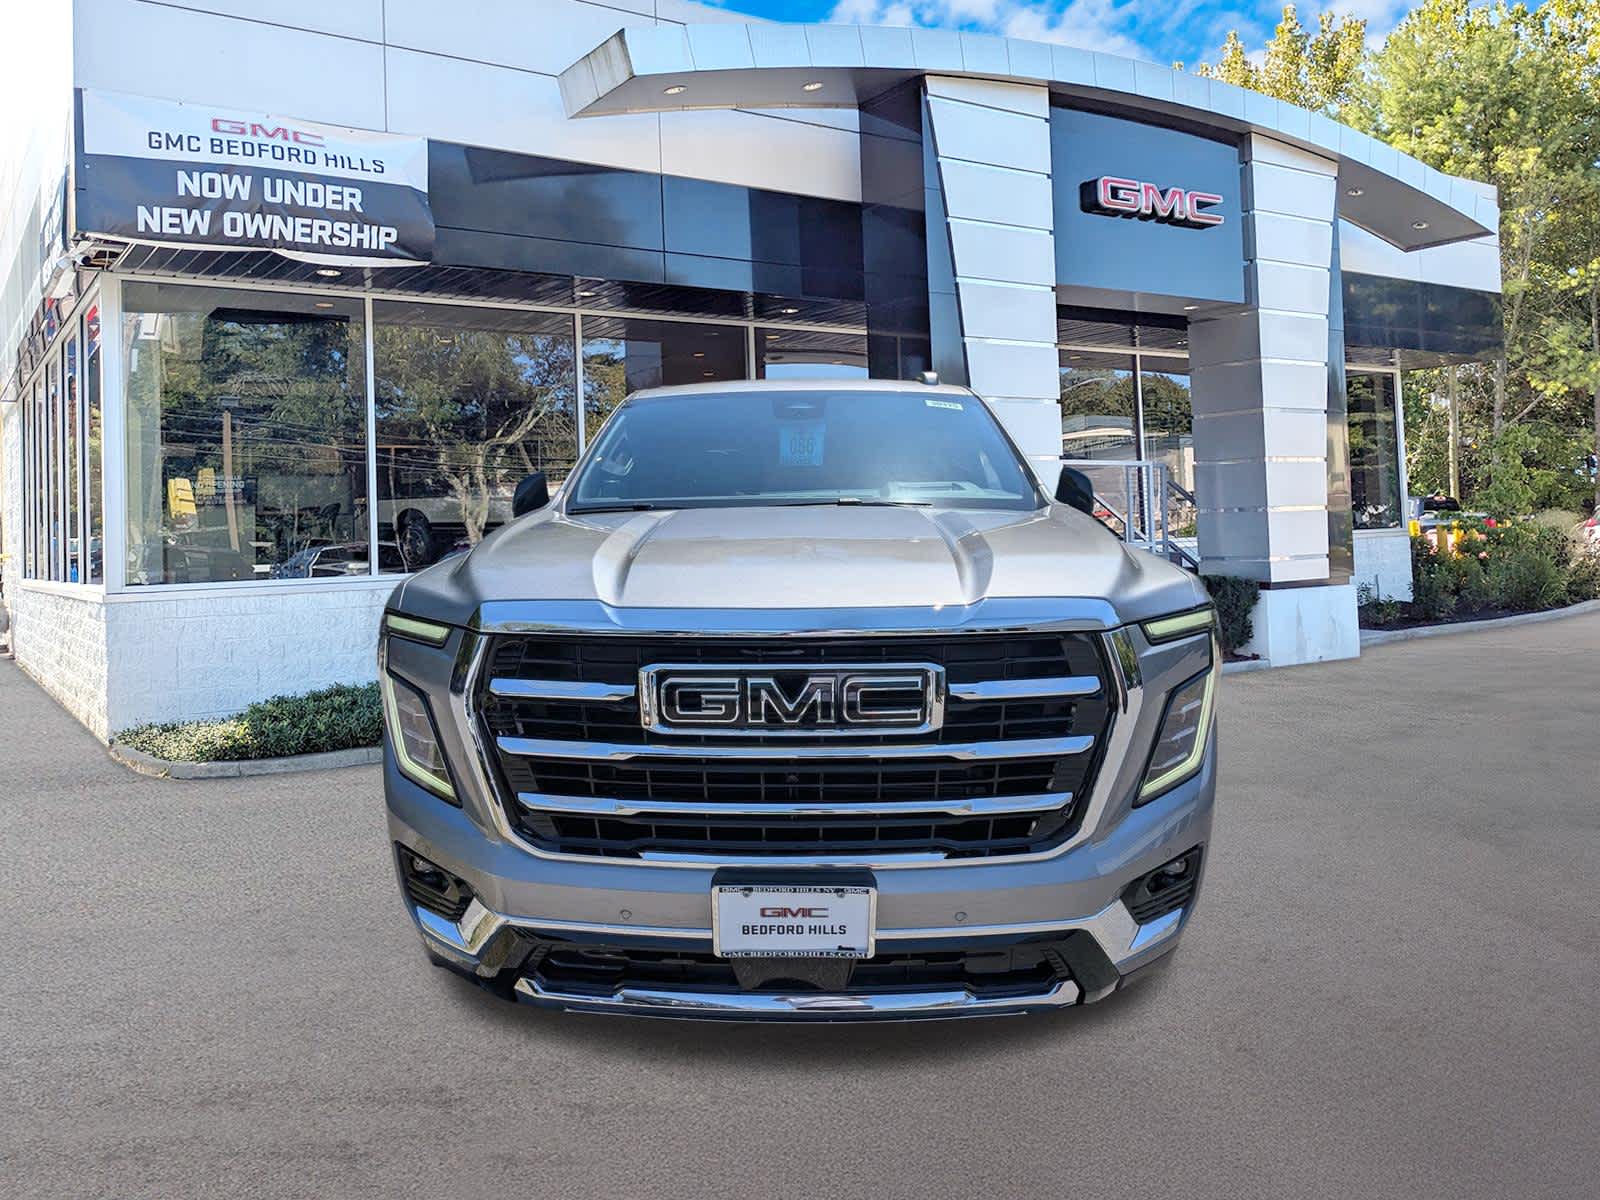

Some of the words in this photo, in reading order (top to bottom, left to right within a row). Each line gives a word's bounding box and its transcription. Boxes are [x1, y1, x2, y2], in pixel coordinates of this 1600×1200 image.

[148, 131, 201, 152] GMC
[210, 139, 317, 165] BEDFORD
[325, 154, 385, 174] HILLS
[211, 118, 325, 147] GMC
[176, 170, 252, 201] NOW
[263, 177, 363, 212] UNDER
[1097, 175, 1225, 225] GMC
[136, 205, 212, 236] NEW
[223, 211, 398, 250] OWNERSHIP
[660, 676, 923, 724] GMC
[752, 886, 794, 895] BEDFORD
[795, 886, 821, 895] HILLS
[843, 888, 868, 896] GMC
[741, 924, 804, 935] BEDFORD
[808, 924, 847, 935] HILLS
[759, 907, 829, 918] GMC
